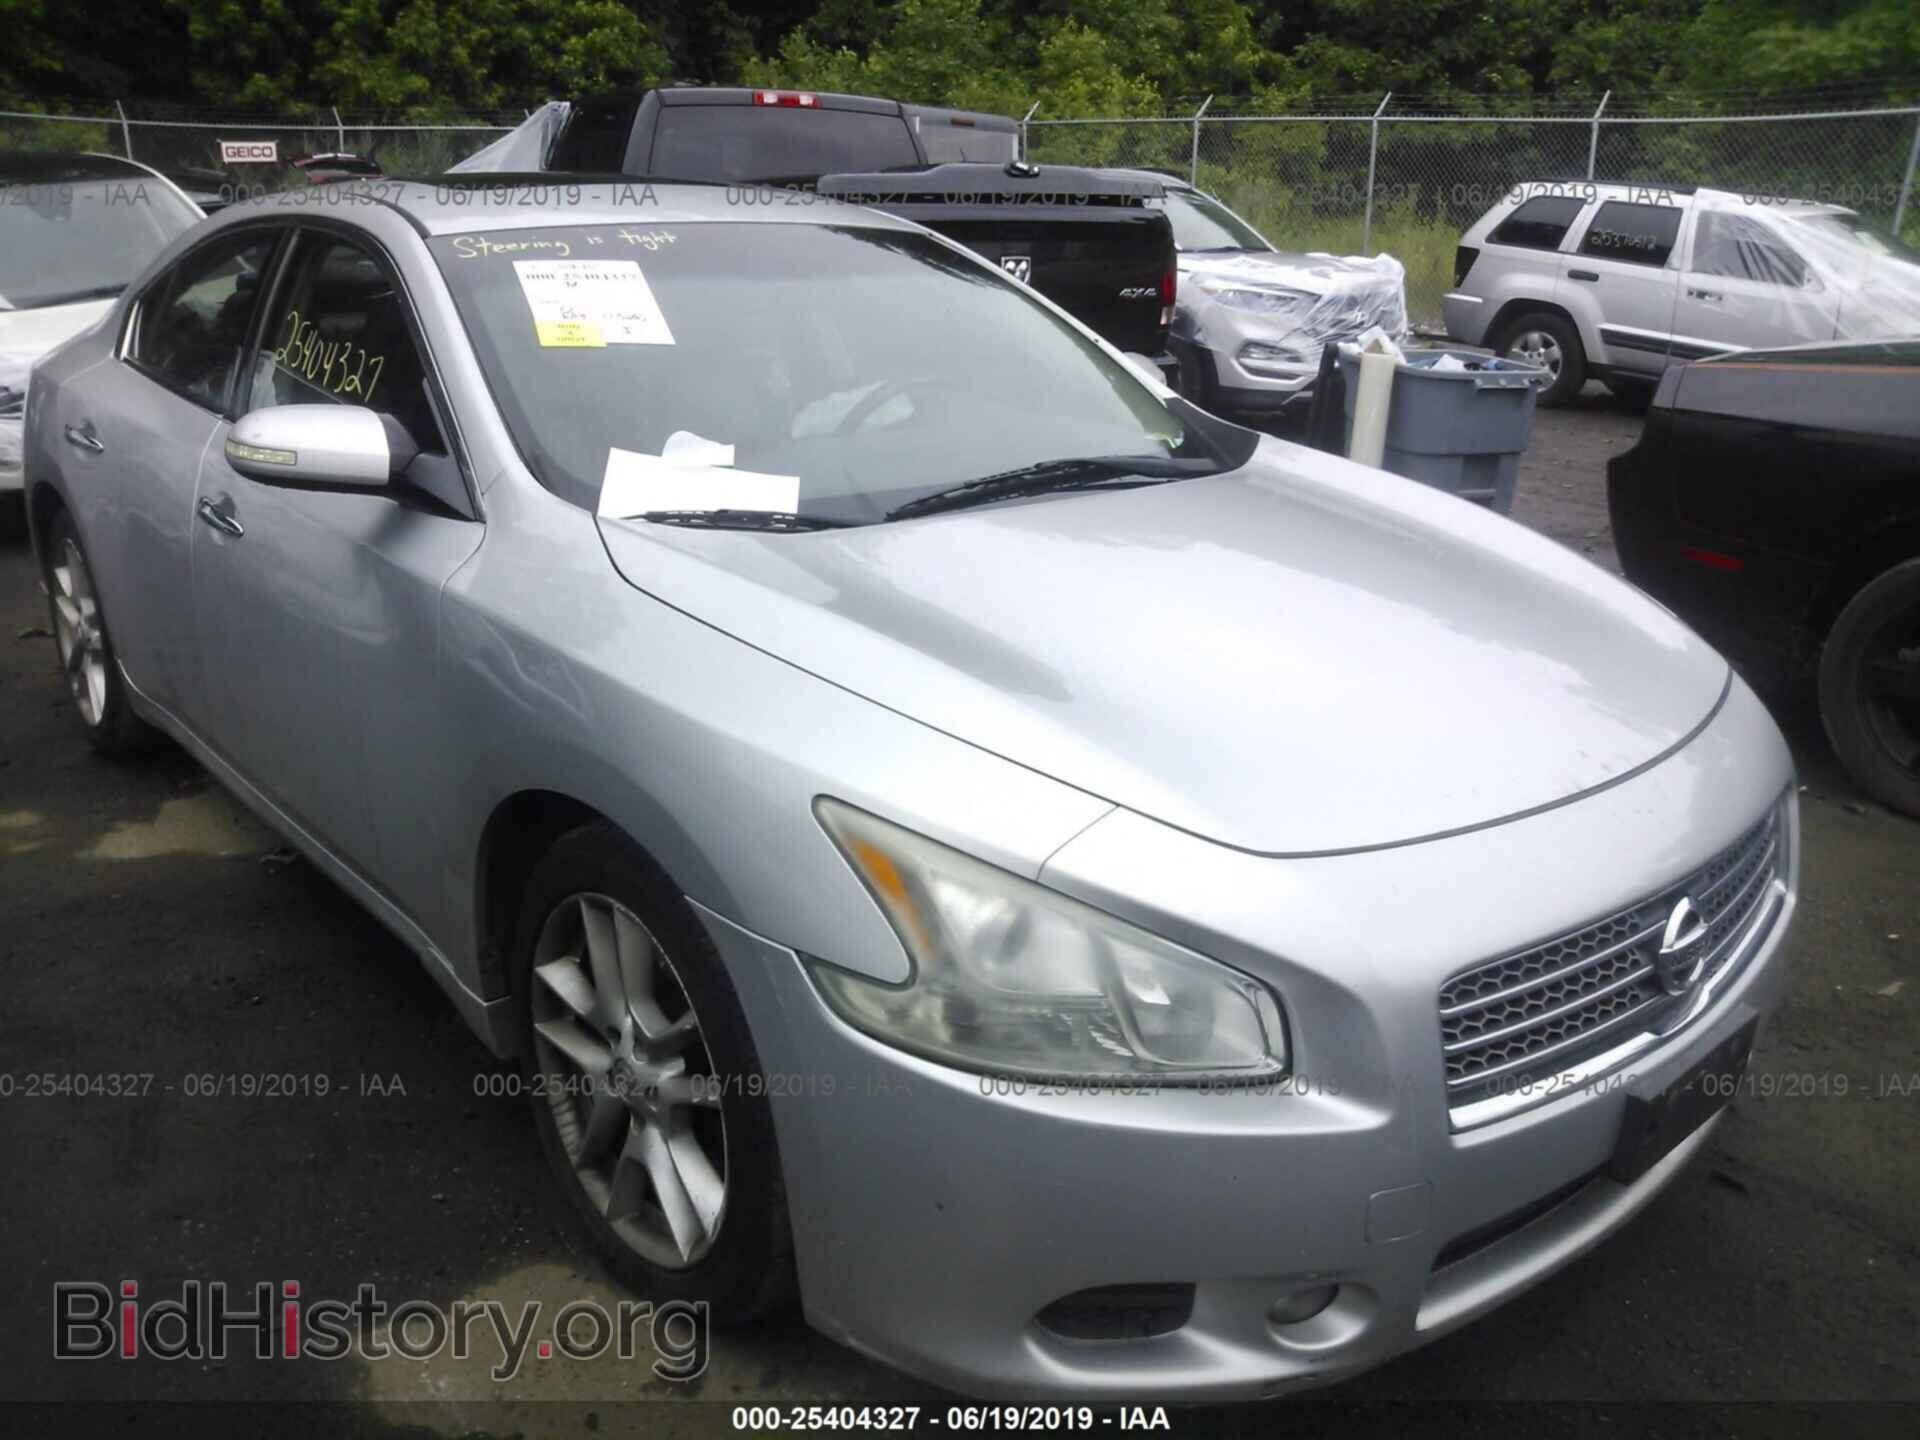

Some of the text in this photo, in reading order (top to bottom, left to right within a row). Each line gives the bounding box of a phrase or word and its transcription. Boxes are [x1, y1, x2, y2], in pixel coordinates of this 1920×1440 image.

[224, 146, 274, 158] GEICO
[452, 236, 570, 258] Steering
[275, 310, 384, 403] 25404327
